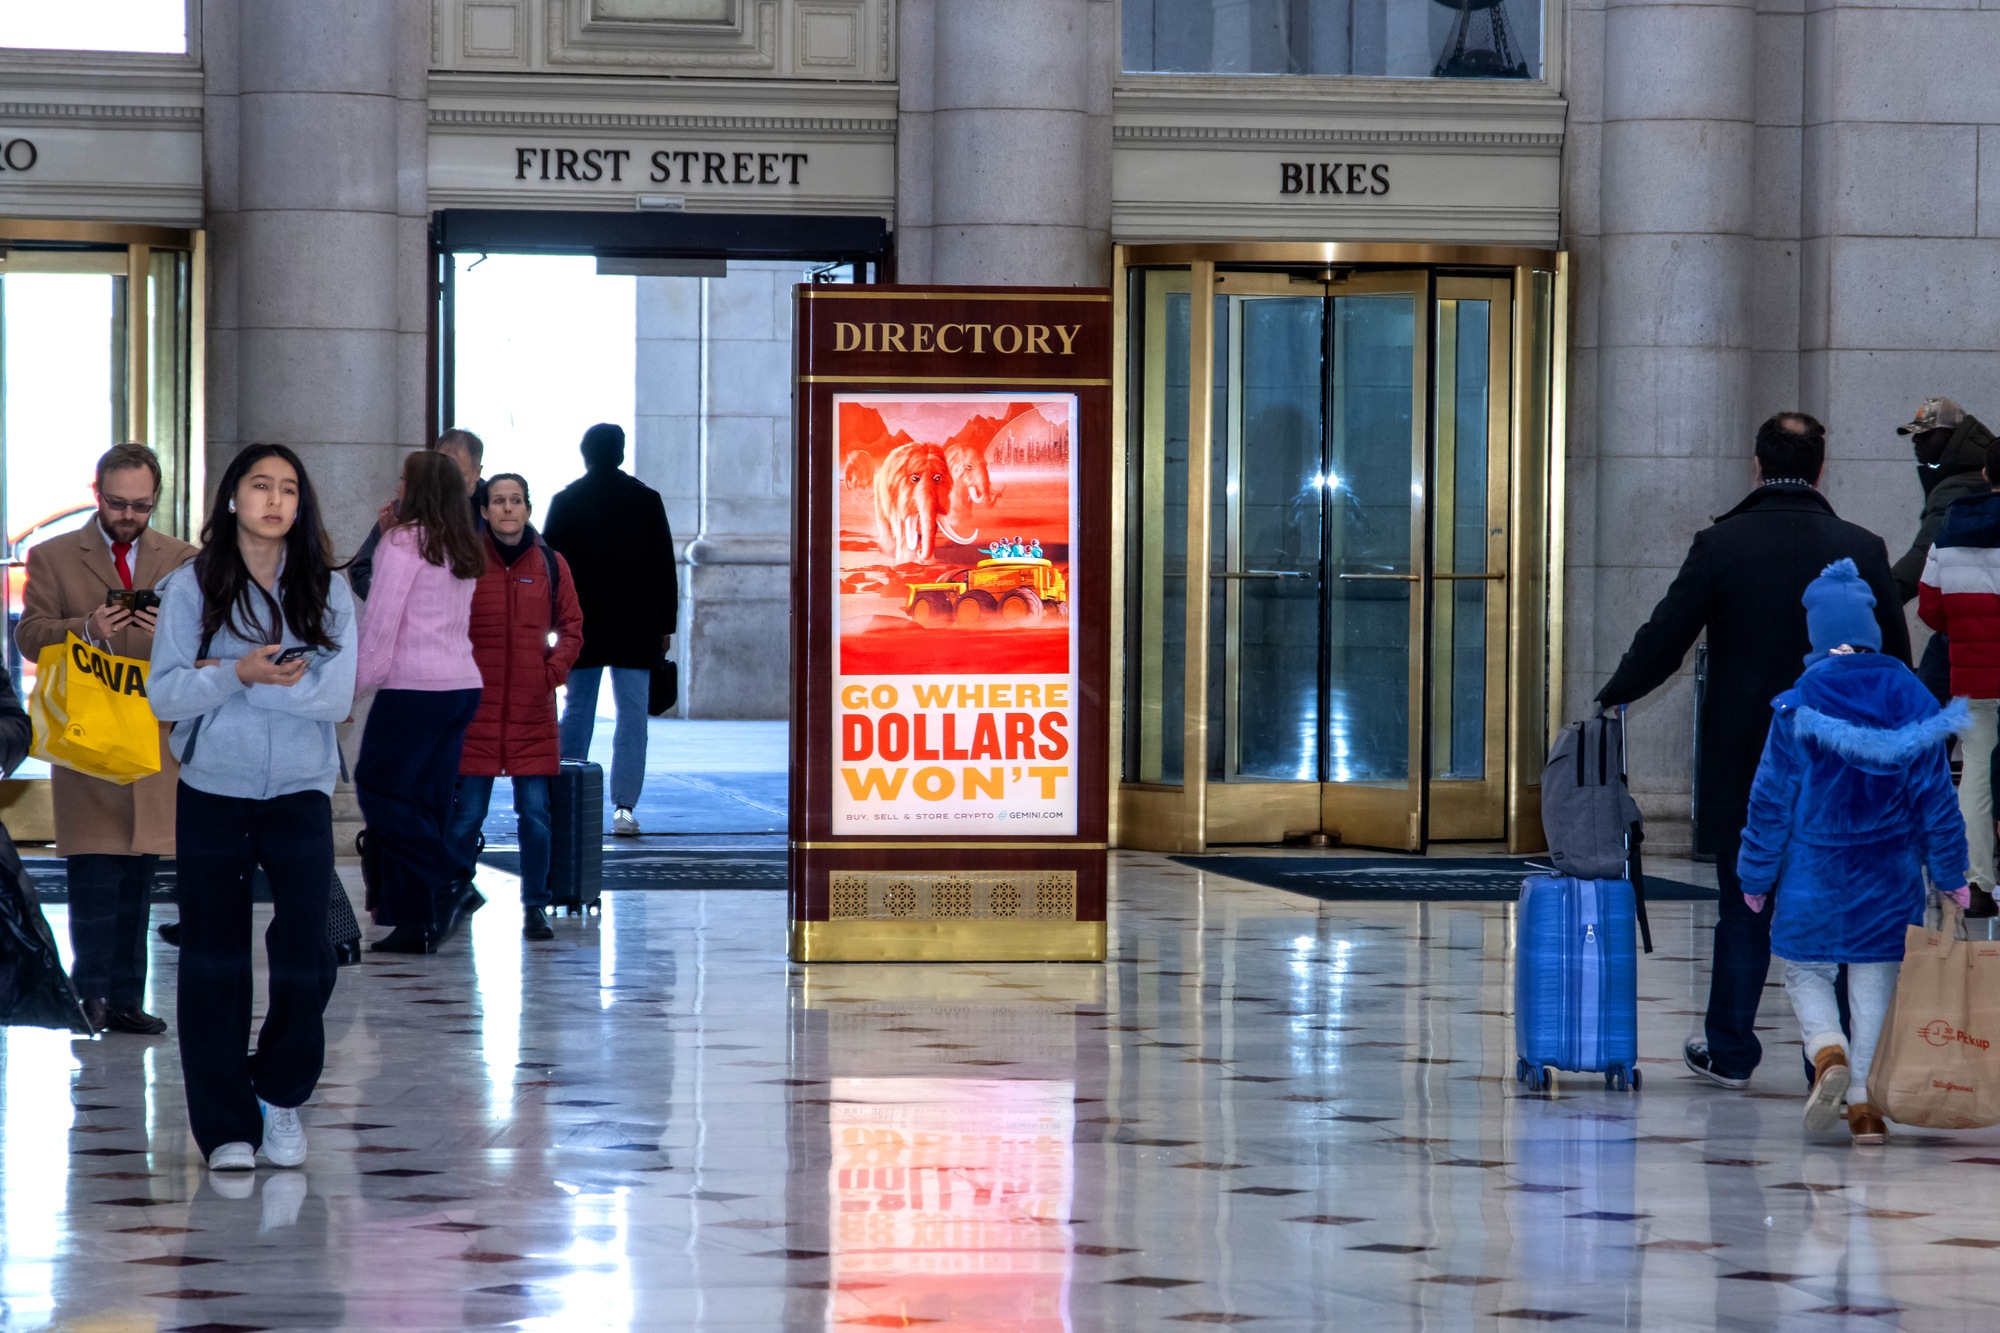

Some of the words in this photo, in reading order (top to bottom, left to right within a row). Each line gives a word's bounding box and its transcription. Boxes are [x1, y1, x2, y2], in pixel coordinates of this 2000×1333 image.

[0, 138, 37, 171] O
[515, 147, 630, 182] FIRST
[650, 151, 808, 185] STREET
[1280, 162, 1390, 196] BIKES
[833, 321, 1082, 355] DIRECTORY
[72, 643, 147, 698] CAVA
[840, 684, 899, 709] GO
[912, 684, 1069, 708] WHERE
[842, 711, 1069, 762] DOLLARS
[840, 766, 1069, 802] WON'T
[954, 812, 995, 820] CRYPTO
[1009, 811, 1064, 820] GEMINI.COM
[1956, 1030, 1990, 1051] Pickup
